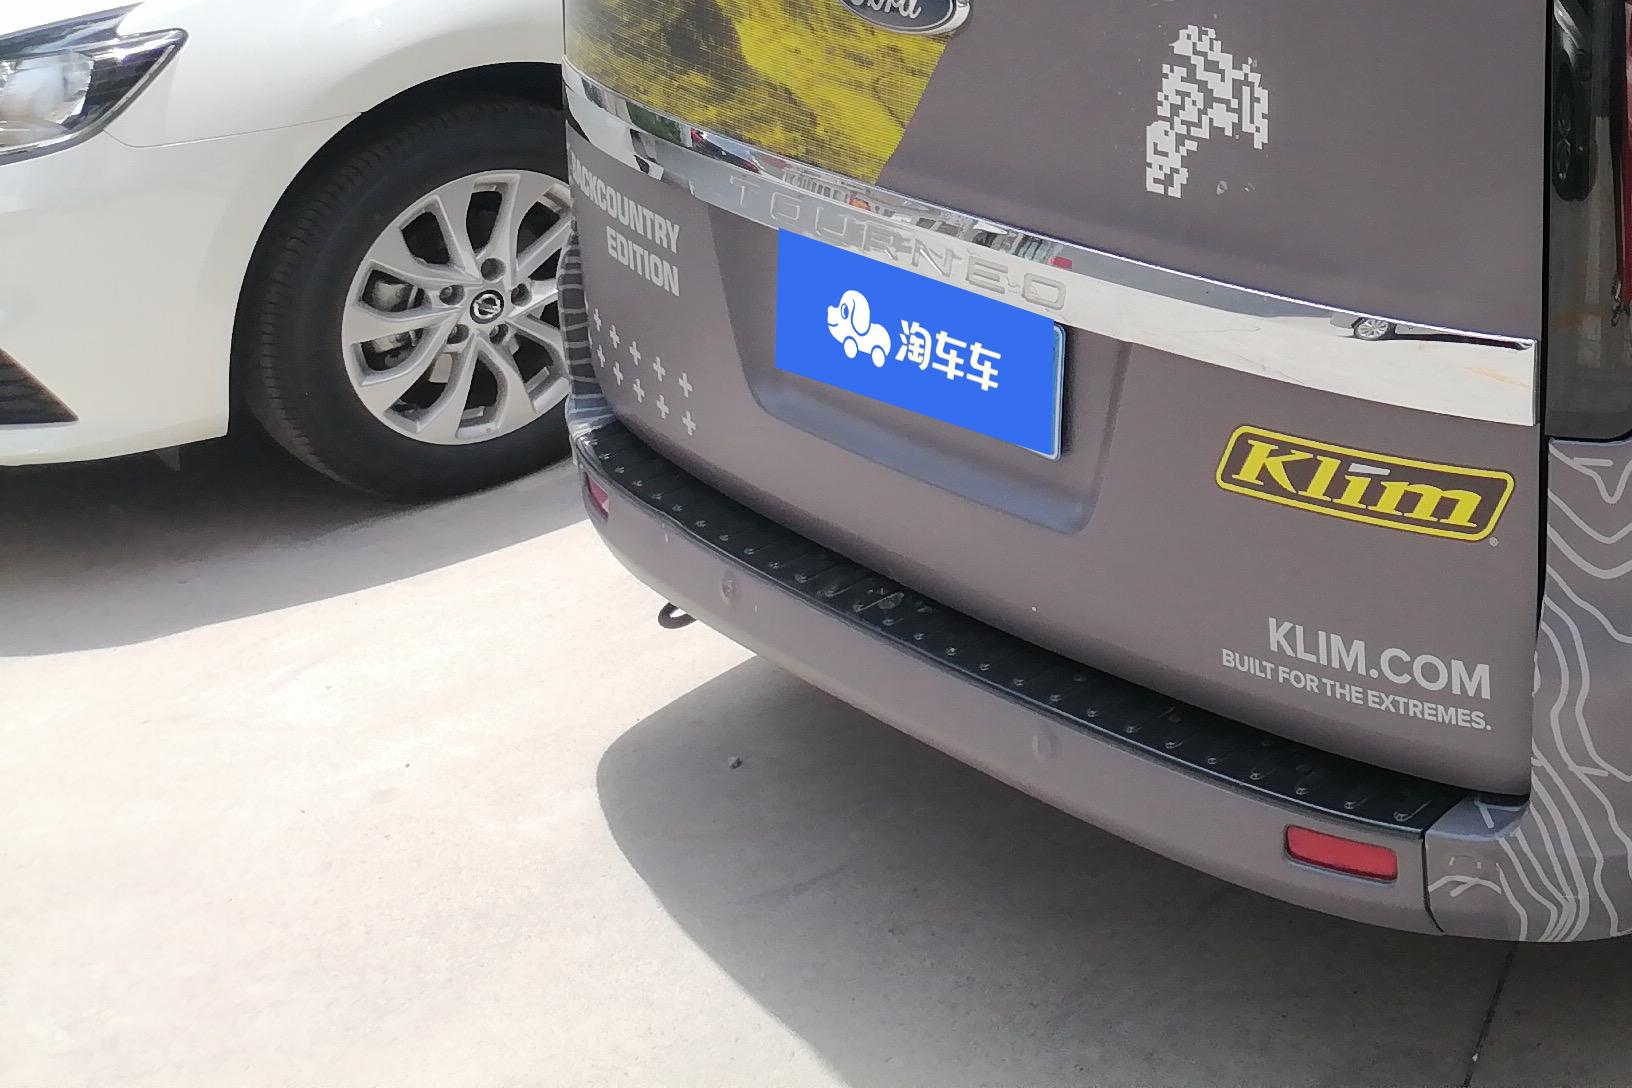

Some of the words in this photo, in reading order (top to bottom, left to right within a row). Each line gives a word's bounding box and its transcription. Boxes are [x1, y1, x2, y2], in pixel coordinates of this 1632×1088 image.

[606, 225, 680, 297] EDITION
[729, 174, 1067, 311] TOURNEO
[1221, 648, 1276, 680] BUILT
[1278, 666, 1320, 694] FOR
[1323, 678, 1365, 706] THE
[1367, 691, 1493, 731] EXTREMES.
[1268, 616, 1492, 700] KLIM.COM
